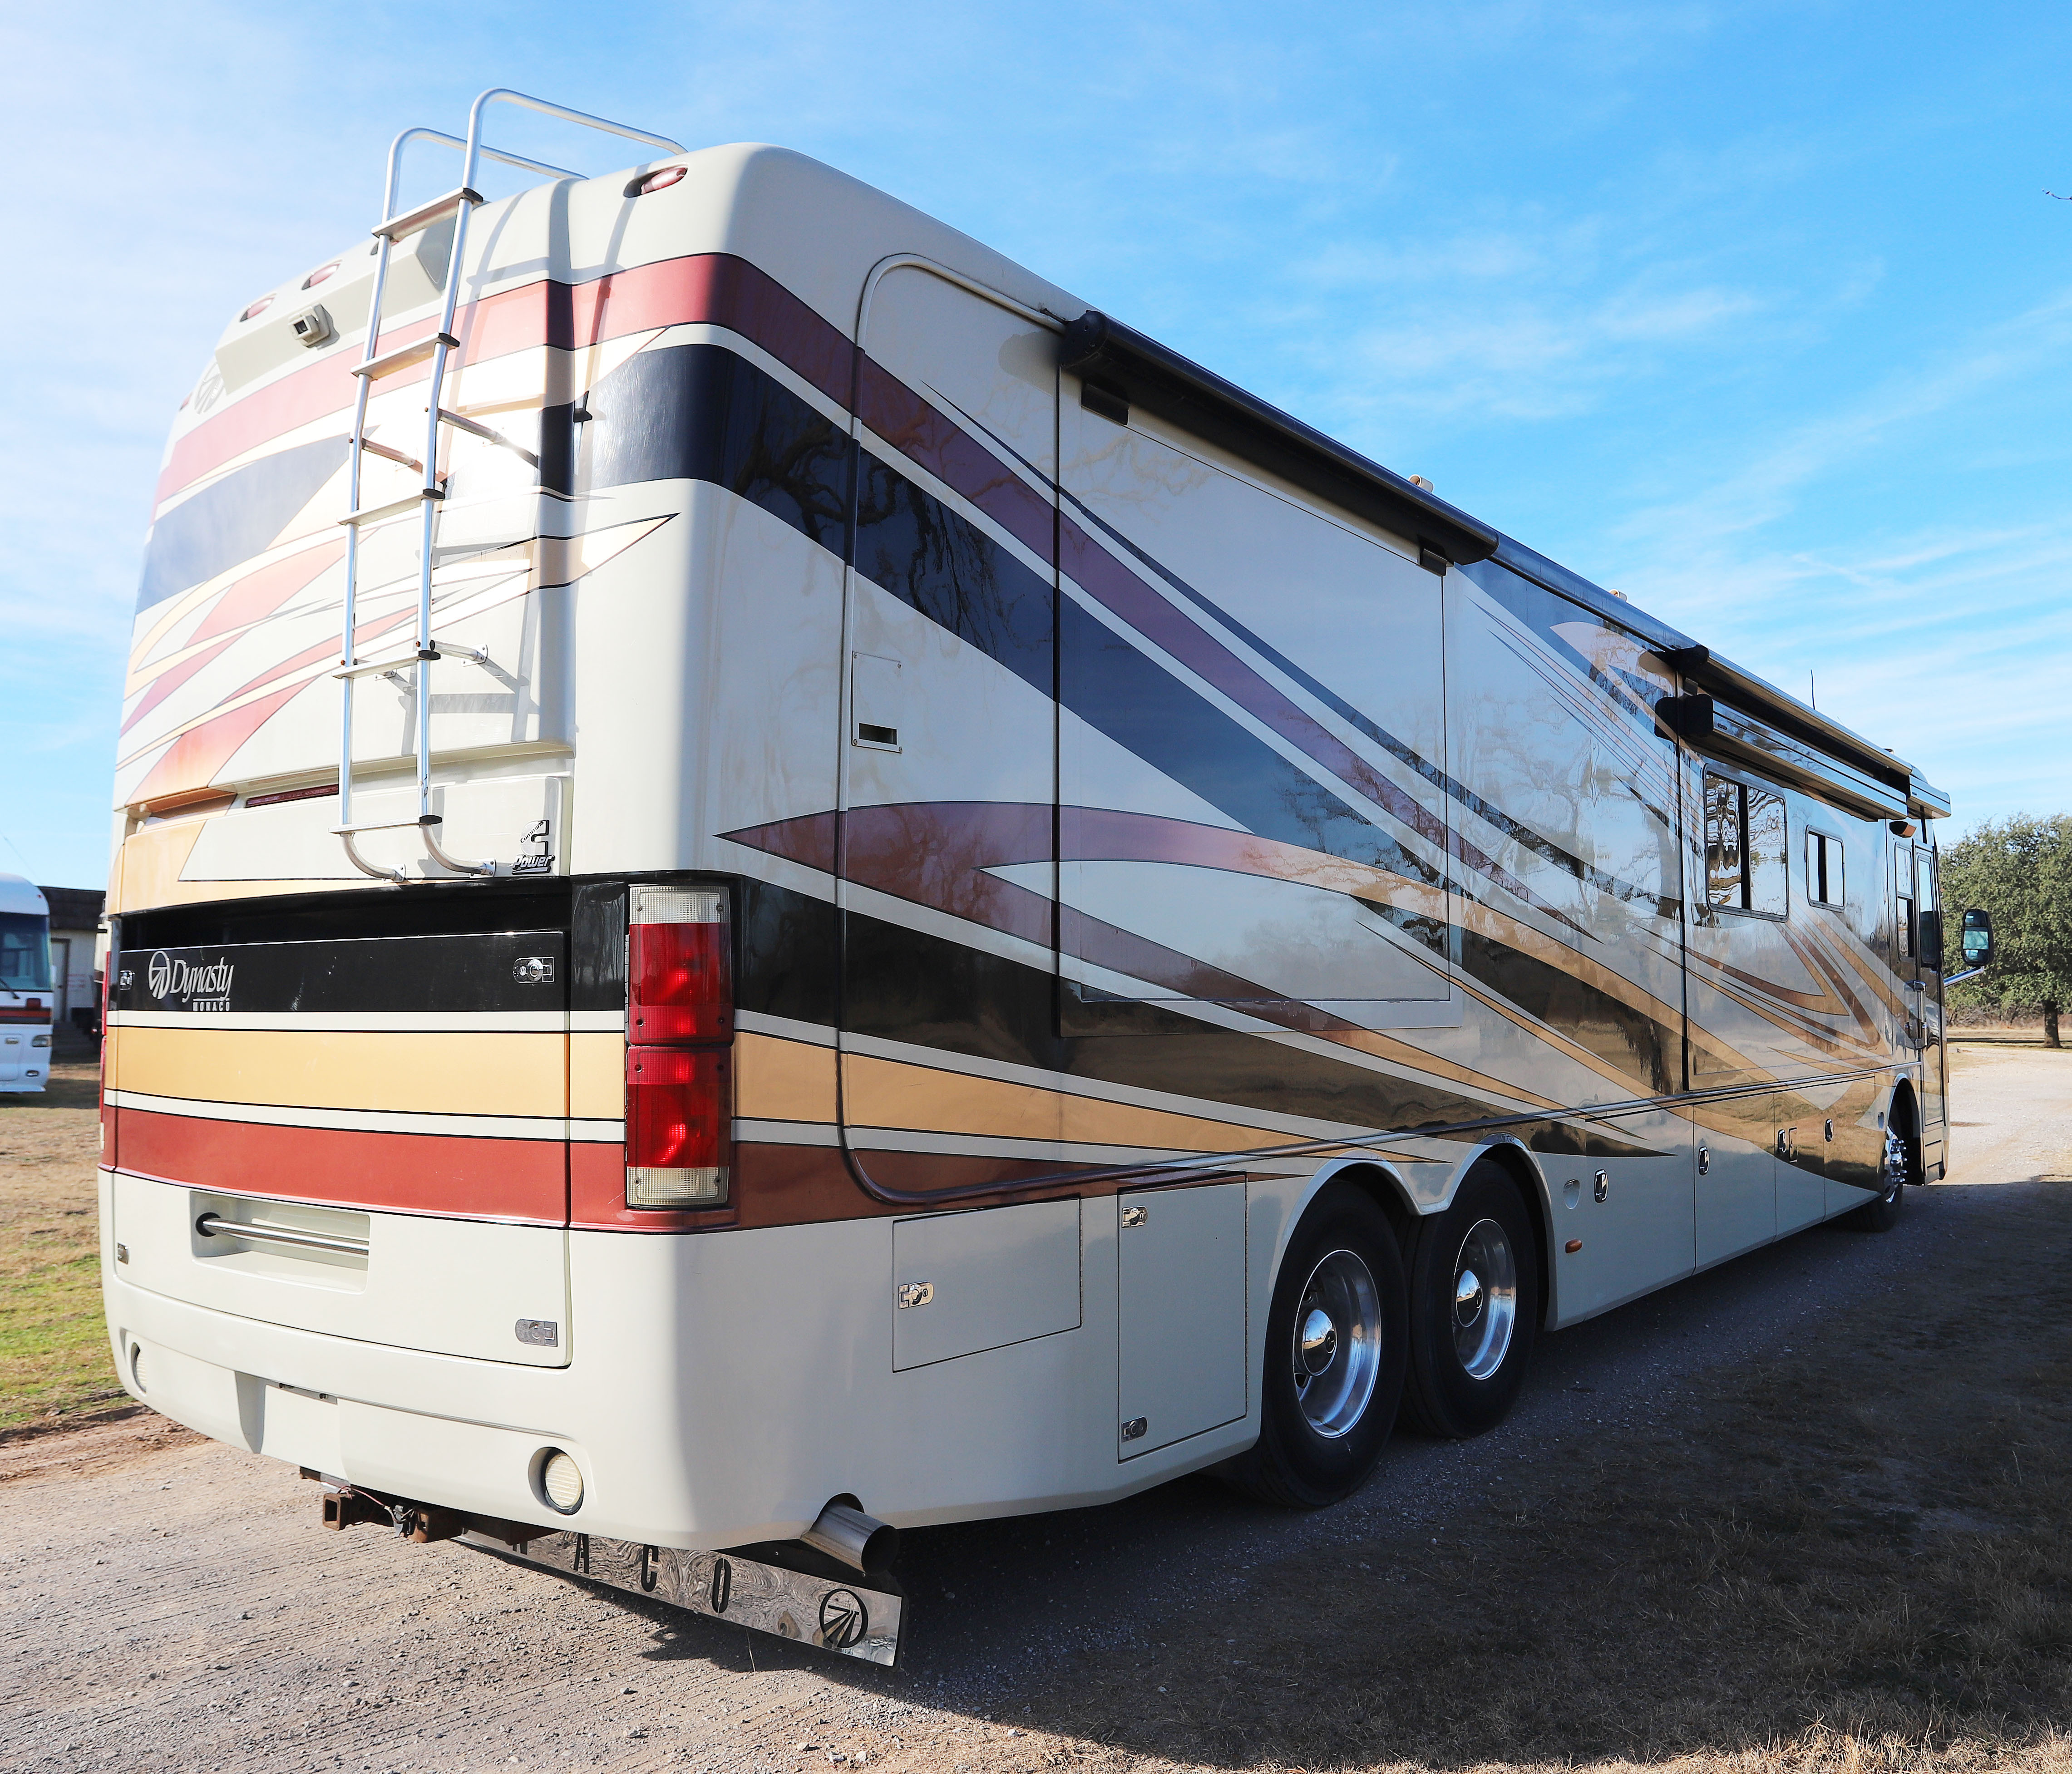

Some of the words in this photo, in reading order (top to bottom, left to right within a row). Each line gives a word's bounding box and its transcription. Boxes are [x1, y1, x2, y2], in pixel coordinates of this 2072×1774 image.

[520, 821, 544, 843] Cummins
[513, 855, 555, 869] Power
[169, 956, 234, 1003] Dynasty
[192, 1001, 230, 1011] MONACO
